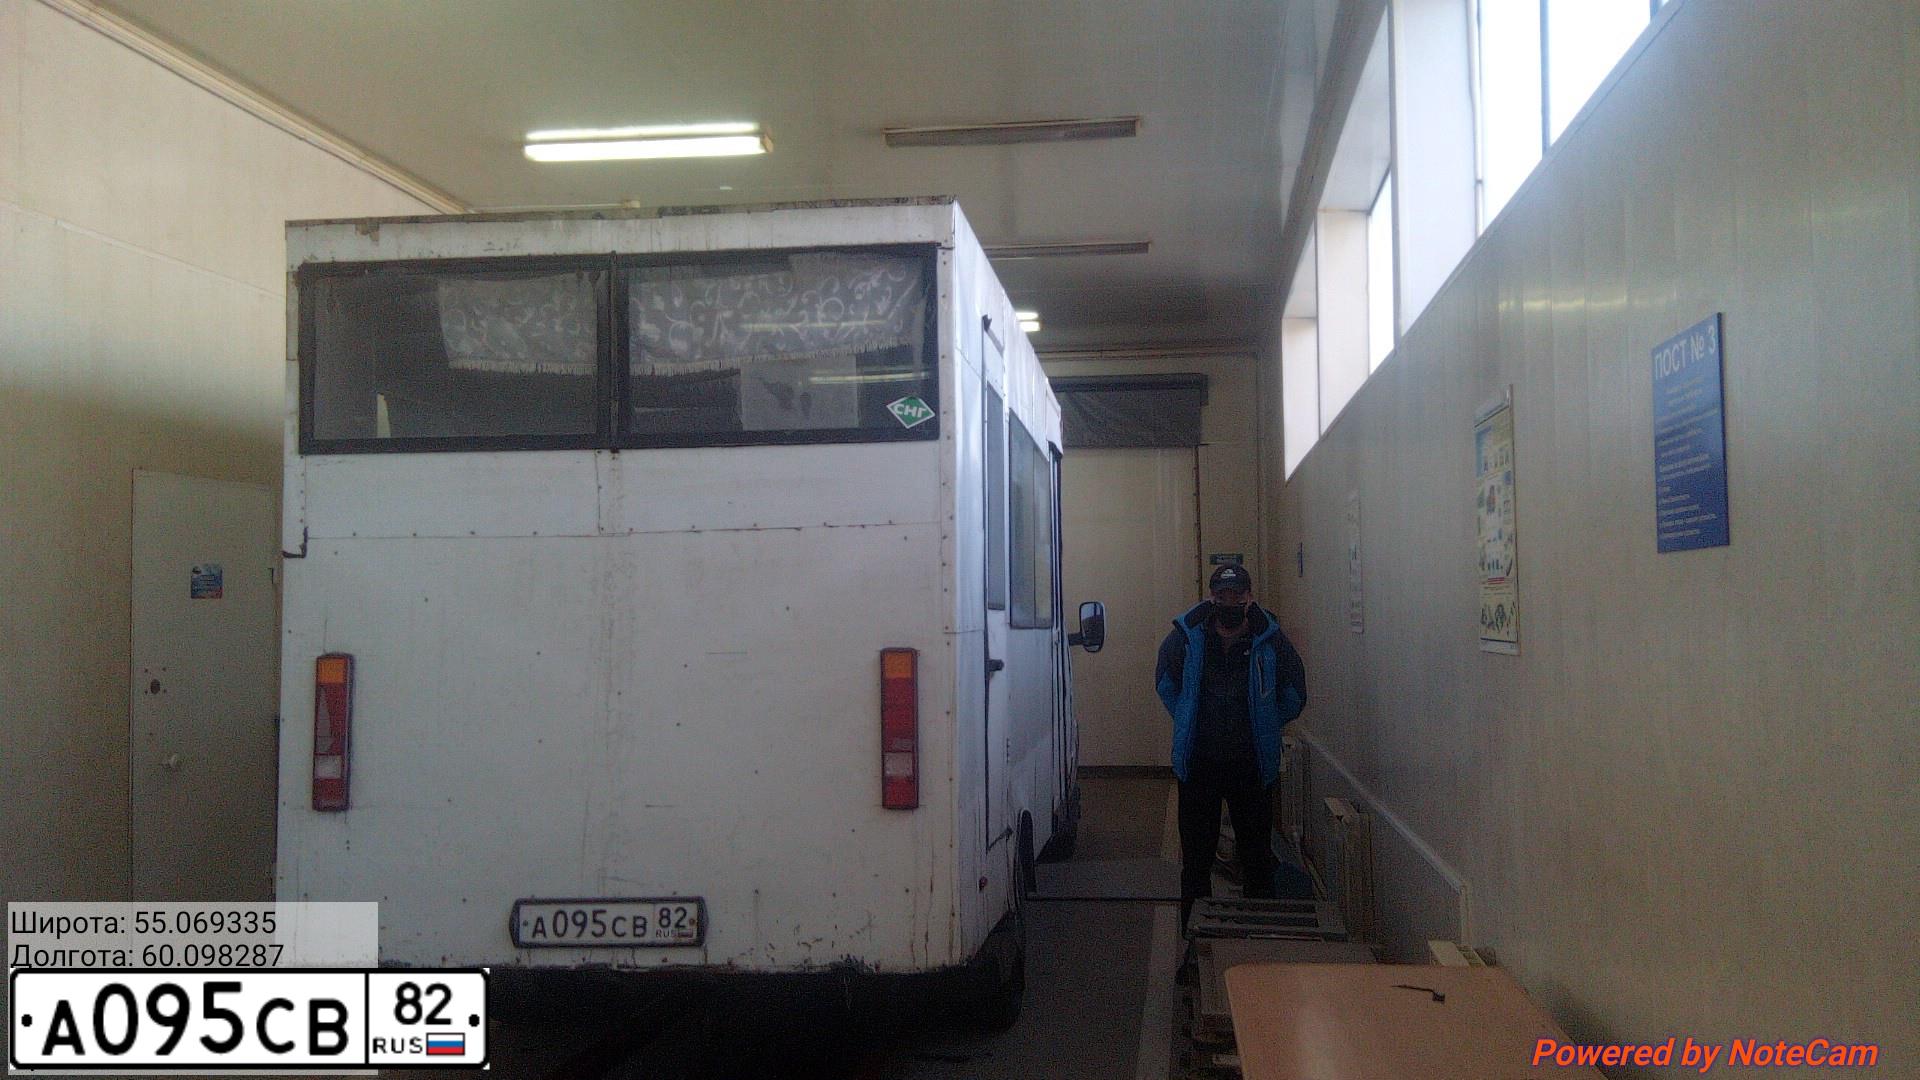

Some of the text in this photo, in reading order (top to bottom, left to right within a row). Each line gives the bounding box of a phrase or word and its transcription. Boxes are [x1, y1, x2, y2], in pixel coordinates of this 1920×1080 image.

[1655, 326, 1717, 380] ПОСТ № 3
[894, 404, 927, 417] СНГ
[658, 906, 687, 929] 82
